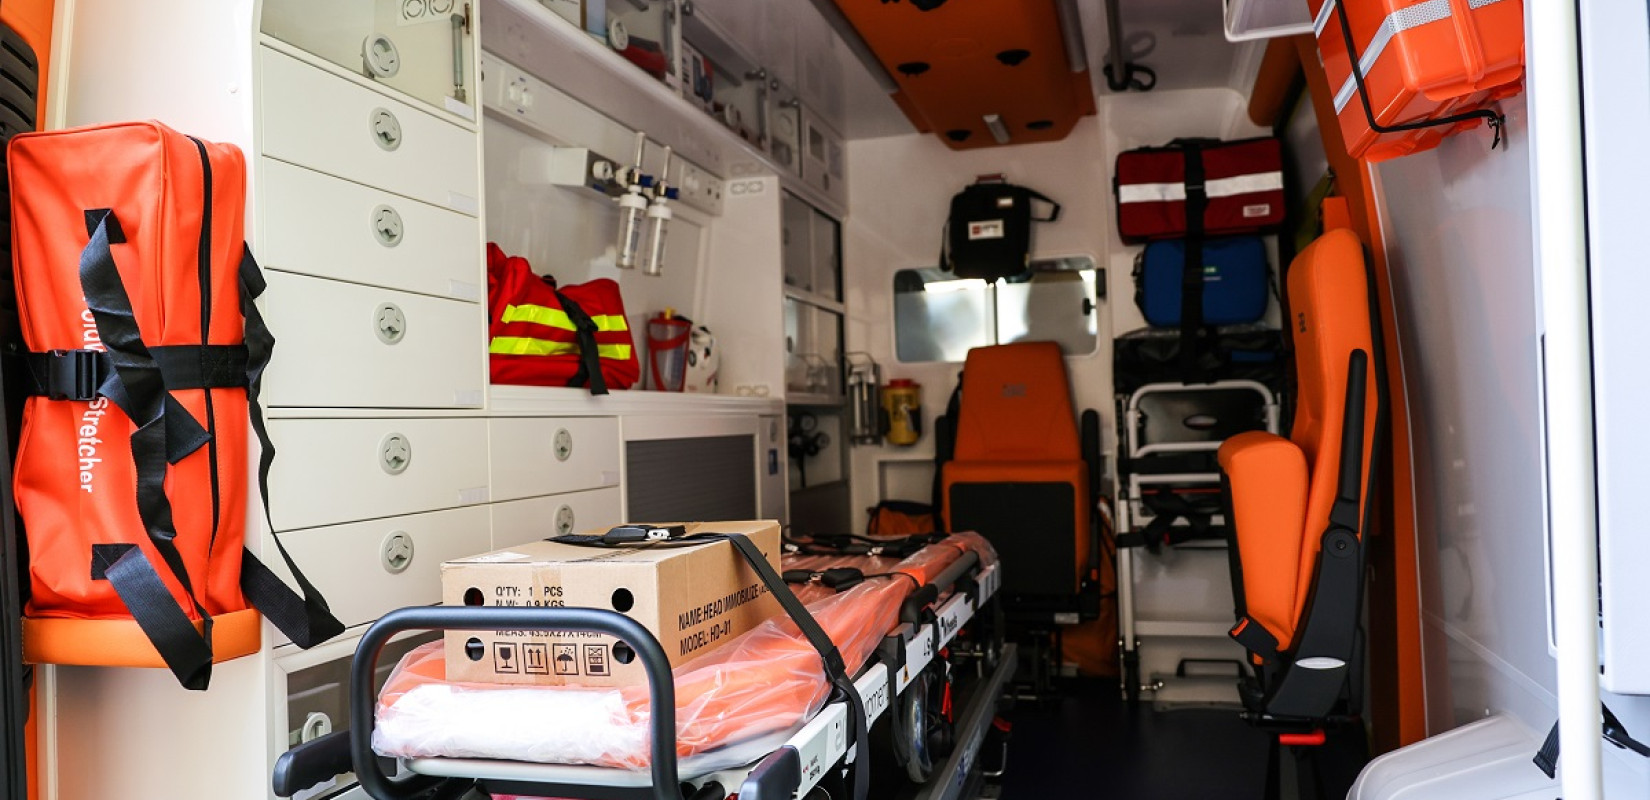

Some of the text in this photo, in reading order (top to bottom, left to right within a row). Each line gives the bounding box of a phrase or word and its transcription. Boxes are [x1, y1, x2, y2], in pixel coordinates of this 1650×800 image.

[79, 396, 109, 493] Stretcher
[495, 586, 564, 598] Q'TY: 1 PCS
